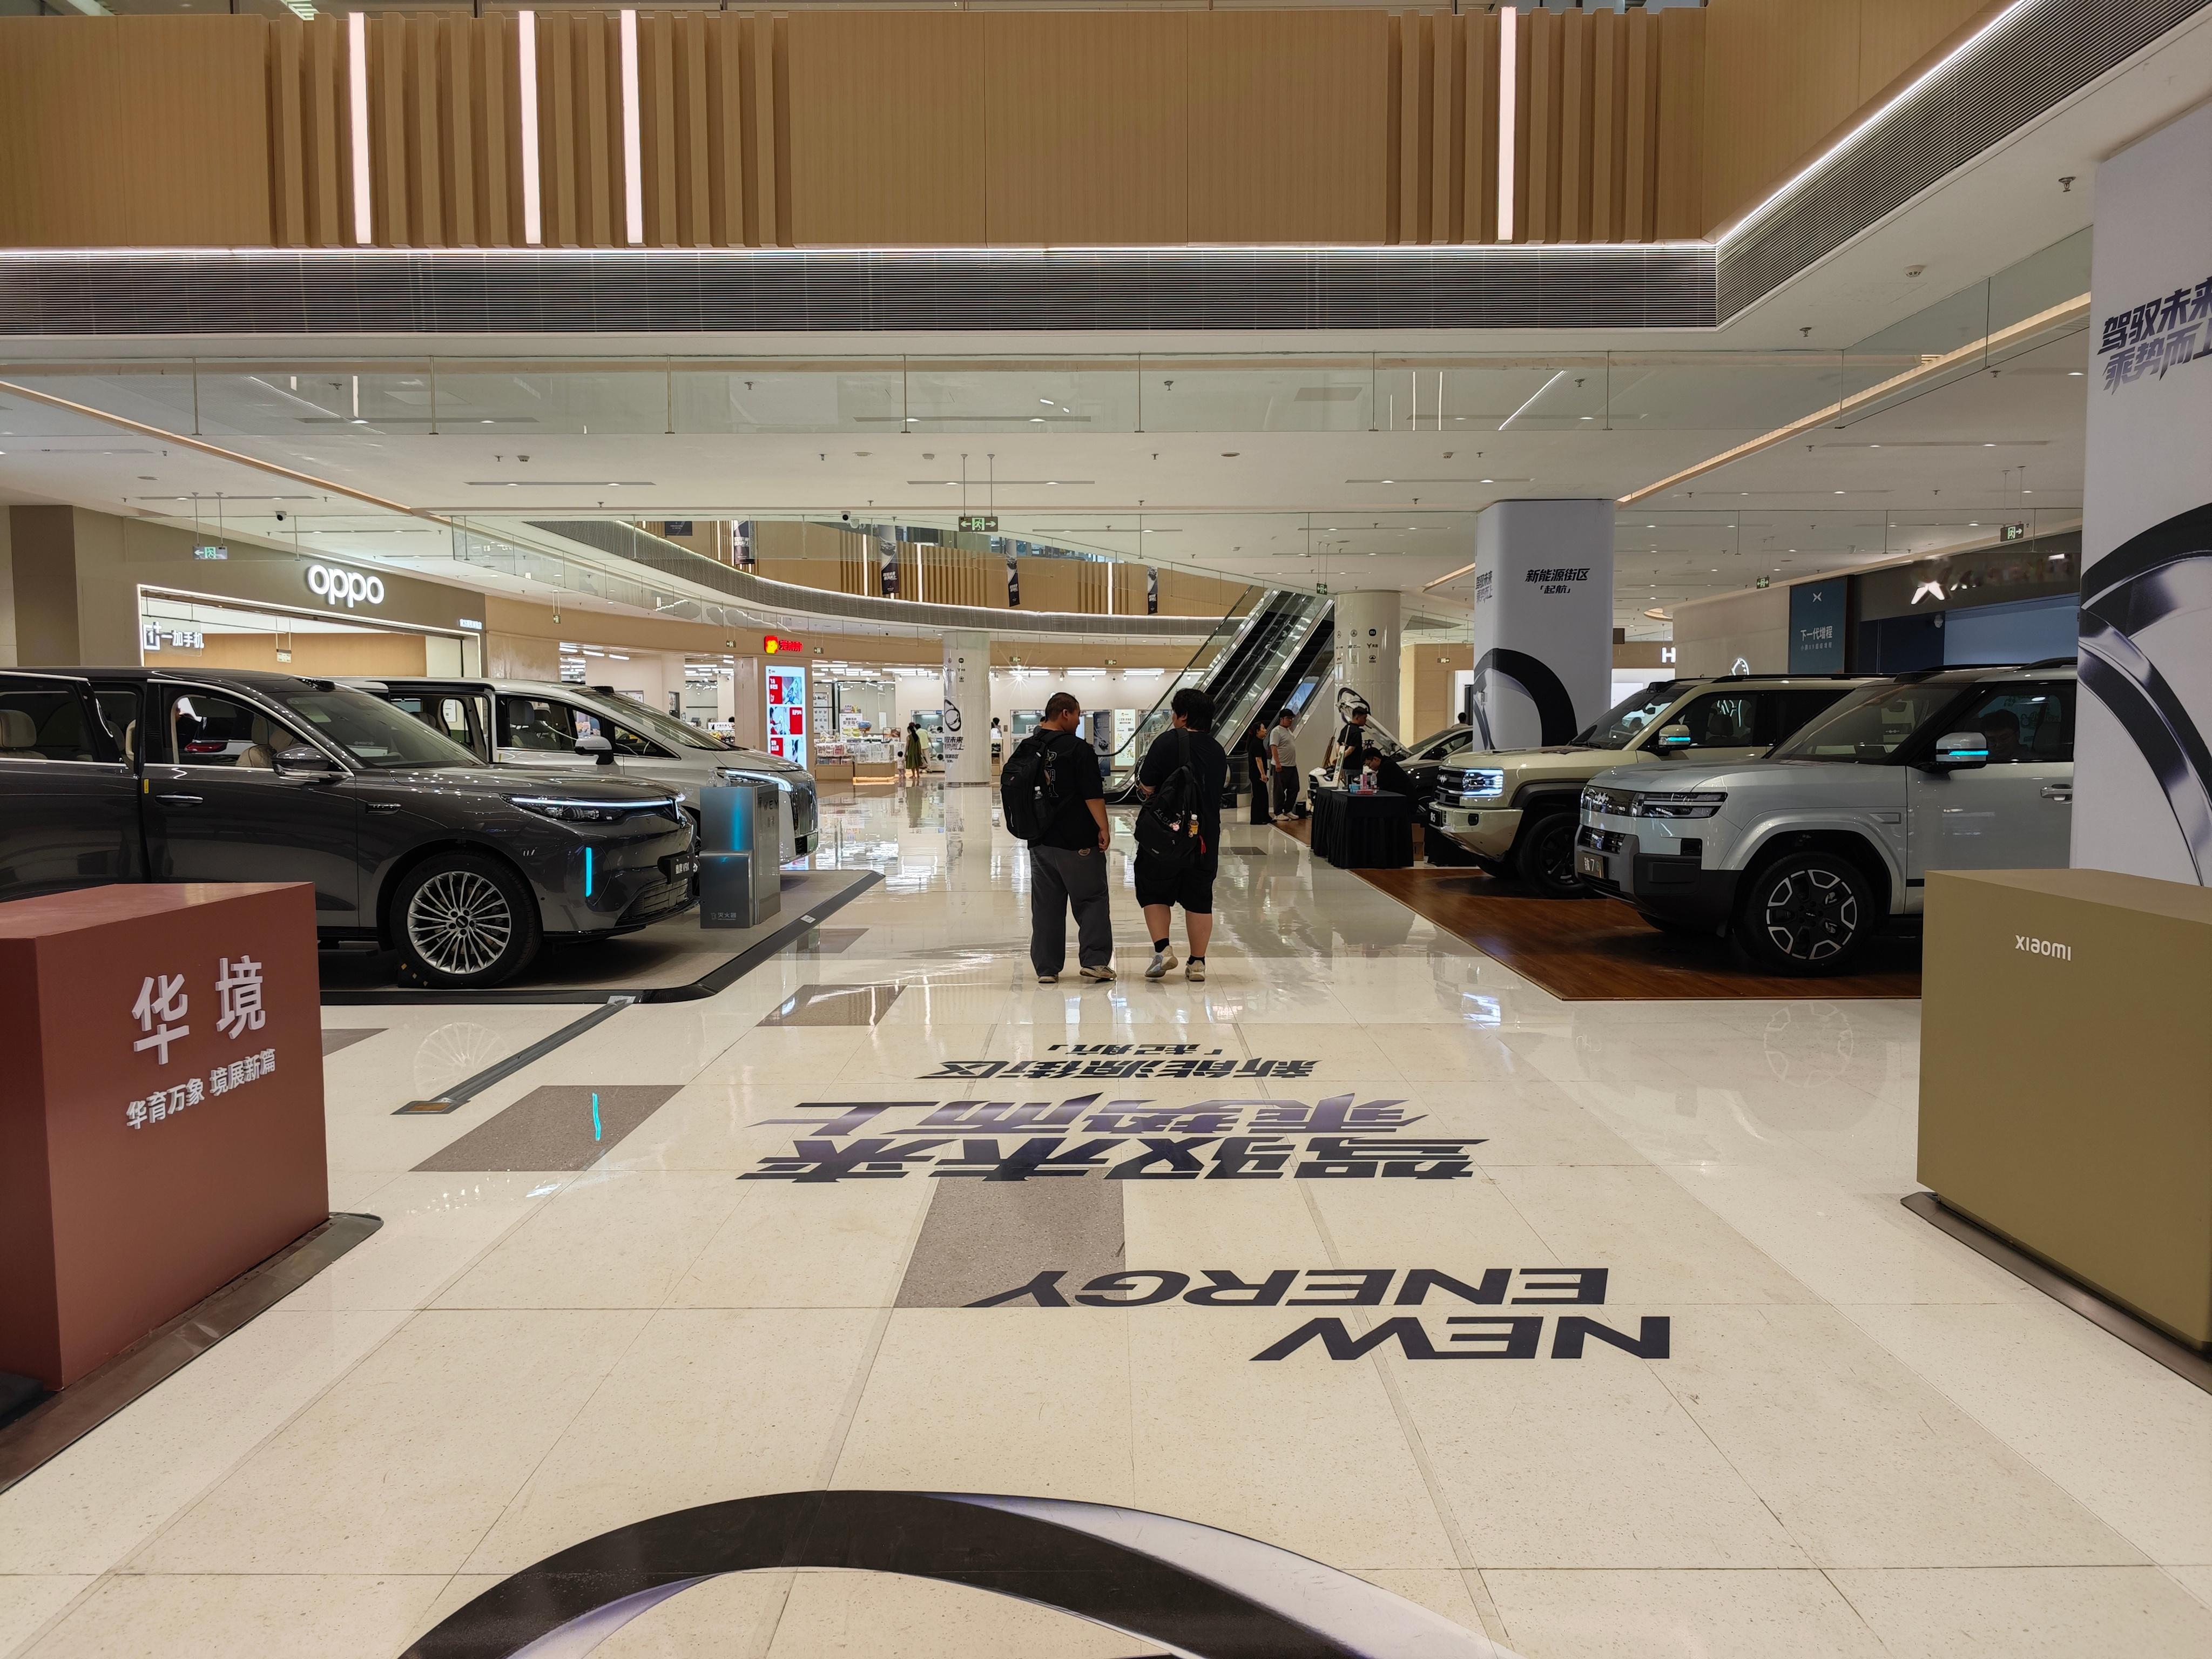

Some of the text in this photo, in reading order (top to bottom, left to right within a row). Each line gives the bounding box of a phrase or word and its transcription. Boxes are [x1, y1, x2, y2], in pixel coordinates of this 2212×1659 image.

[2097, 276, 2212, 355] 驾驭未来
[1475, 571, 1493, 590] 驾驭未来
[1525, 568, 1590, 583] 新能源街区
[161, 630, 204, 648] 一加手机
[1800, 626, 1832, 641] 下一代增程
[763, 799, 778, 811] WEY
[2015, 935, 2072, 961] xiaomi
[915, 1060, 1323, 1080] 新能源街区
[126, 1048, 275, 1129] 华育万象 境展新篇
[745, 1092, 1429, 1136] 乘势而上
[737, 1137, 1489, 1183] 驾驭未来
[960, 1268, 1608, 1307] ENERGY
[1249, 1316, 1671, 1361] NEW
